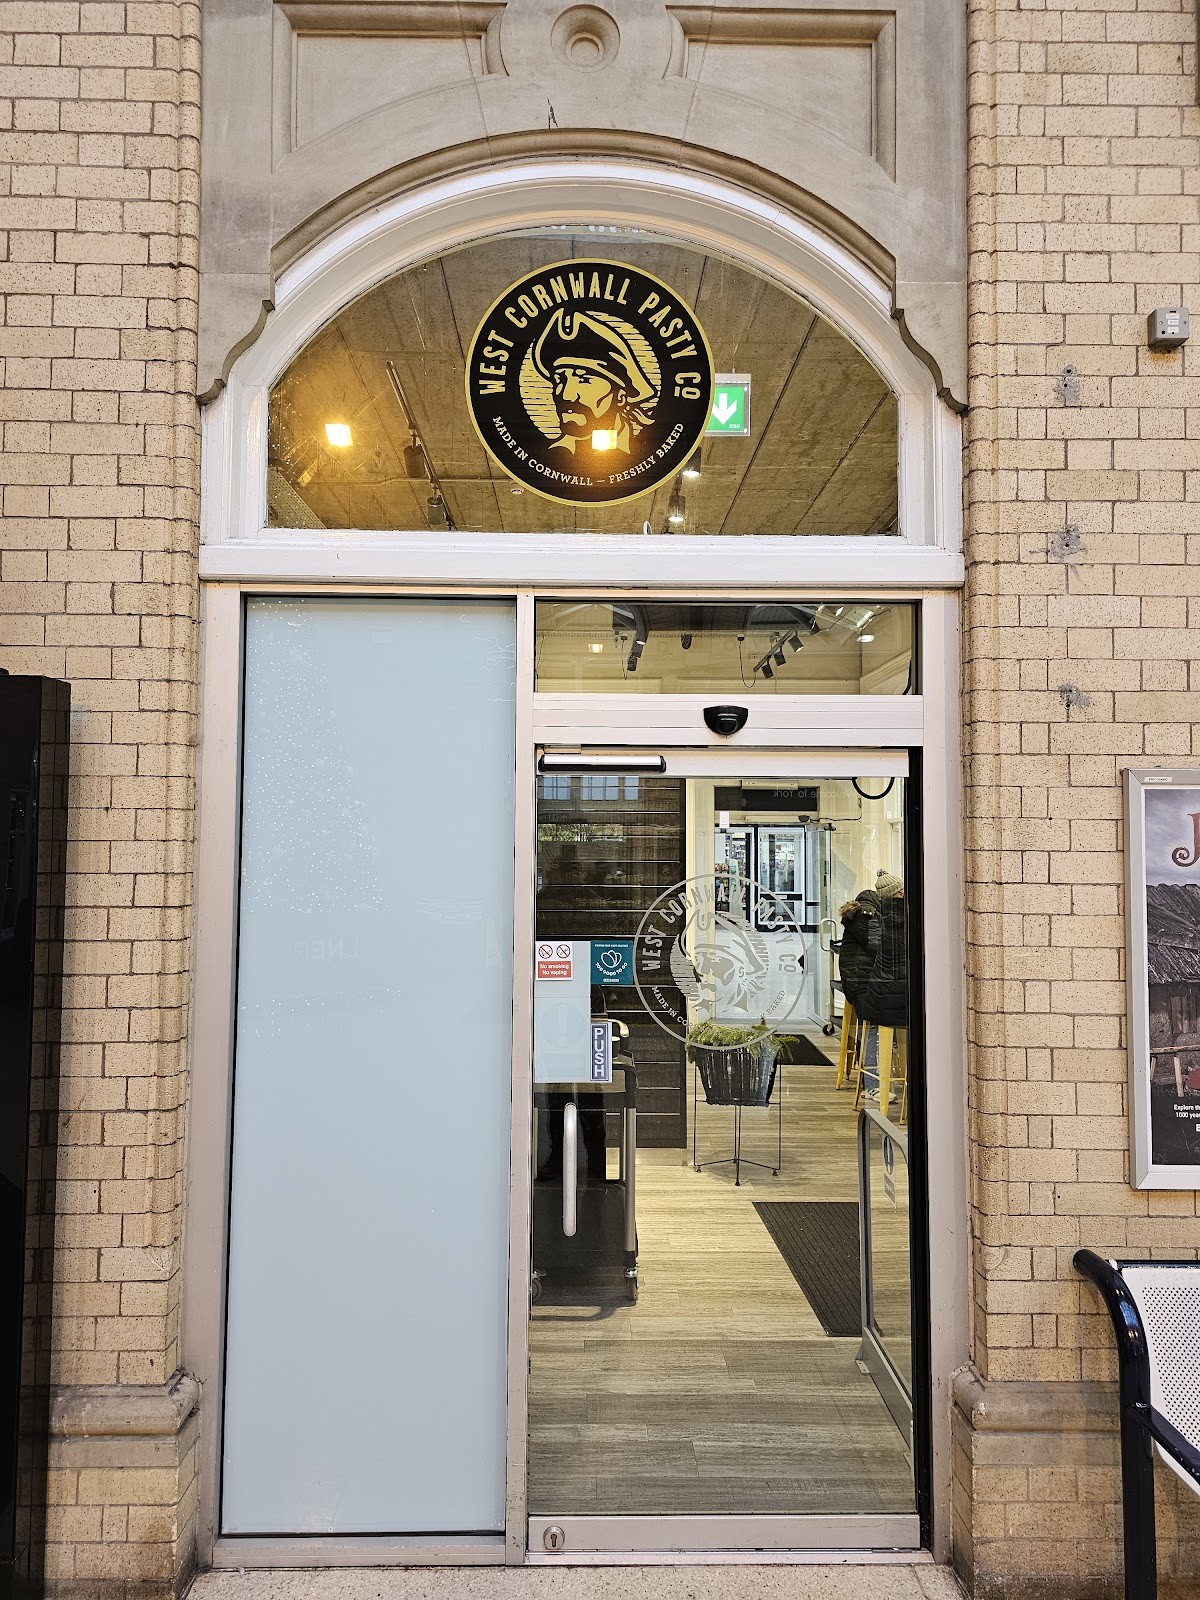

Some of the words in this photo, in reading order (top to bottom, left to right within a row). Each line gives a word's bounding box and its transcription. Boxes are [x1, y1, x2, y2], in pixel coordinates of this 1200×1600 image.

[479, 330, 514, 395] WEST
[504, 271, 631, 328] CORNWALL
[637, 292, 698, 360] PASTY
[492, 415, 515, 450] MADE
[513, 446, 528, 461] IN
[528, 459, 593, 486] CORNWALL
[608, 455, 657, 484] FRESHLY
[658, 423, 685, 459] BAKED
[641, 924, 667, 971] WEST
[659, 883, 747, 924] CORNWALL
[751, 896, 794, 944] PASTY
[595, 962, 603, 972] TOO
[621, 962, 628, 970] GO
[651, 985, 670, 1010] MADE
[667, 1007, 678, 1018] IN
[765, 990, 786, 1015] BAKED
[594, 1027, 605, 1077] PUSH
